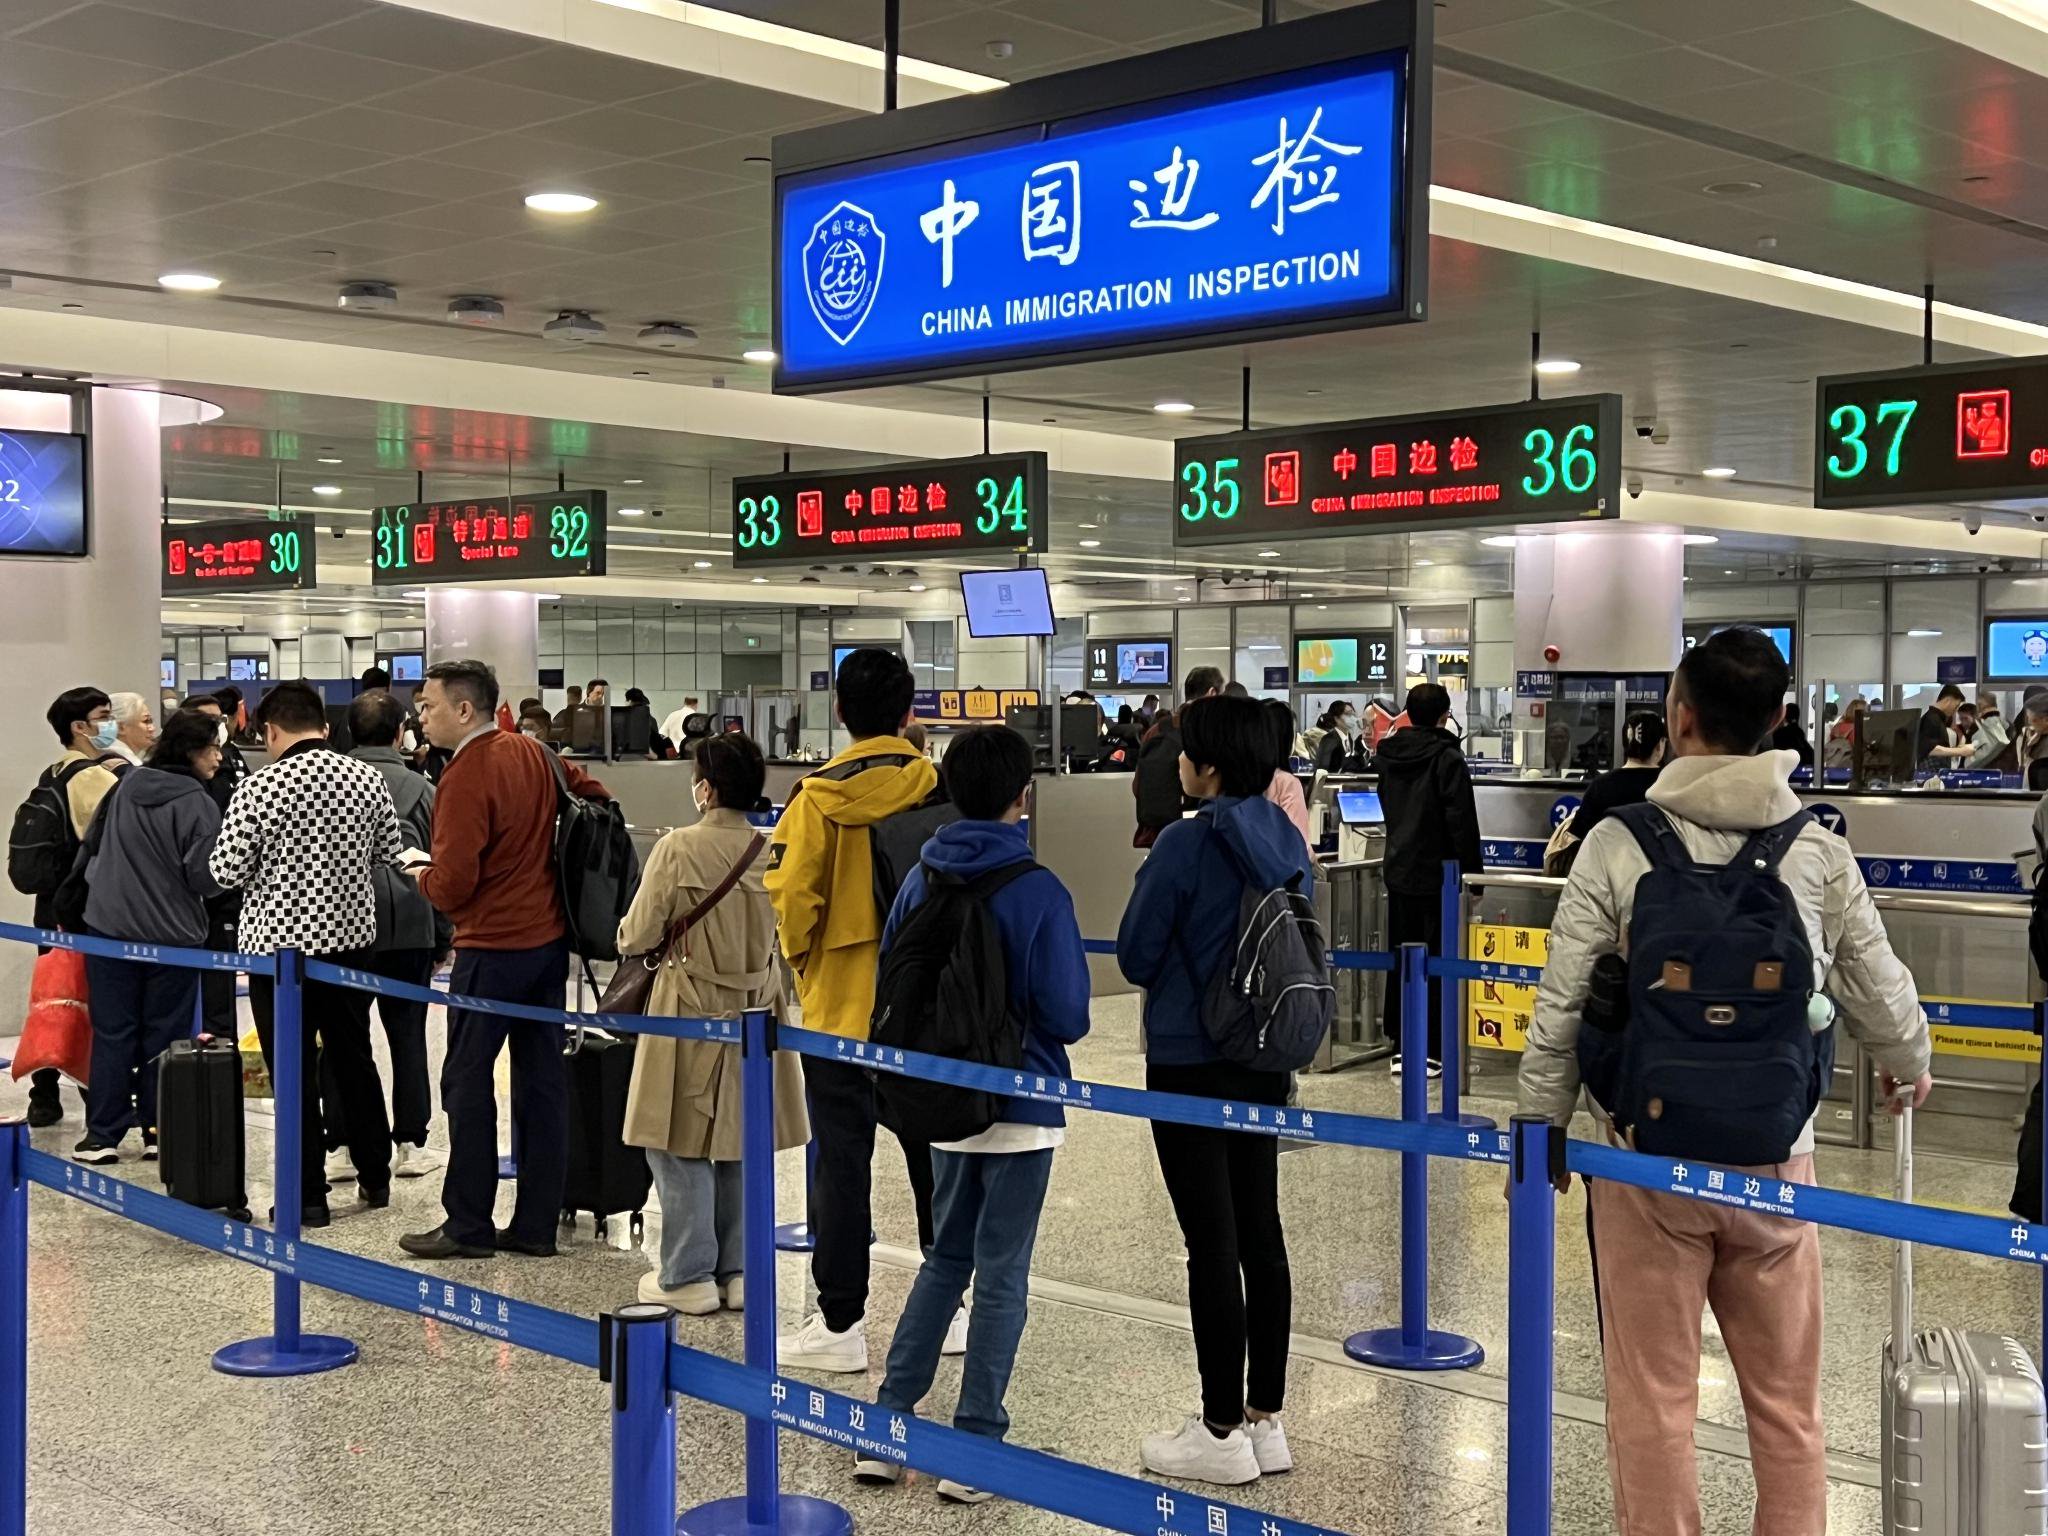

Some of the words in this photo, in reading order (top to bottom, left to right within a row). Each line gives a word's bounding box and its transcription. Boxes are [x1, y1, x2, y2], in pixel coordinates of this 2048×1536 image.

[920, 106, 1363, 288] 中国边检
[921, 309, 993, 336] CHINA
[1005, 278, 1172, 326] IMMIGRATION
[1188, 249, 1361, 300] INSPECTION
[1333, 436, 1480, 481] 中国边检
[1522, 424, 1597, 496] 36
[1827, 400, 1918, 479] 37
[844, 482, 947, 517] 中国边检
[976, 475, 1028, 534] 34
[1181, 458, 1240, 522] 35
[1311, 497, 1346, 513] CHINA
[1429, 484, 1500, 505] INSPECTION
[551, 511, 588, 558] 32
[738, 495, 781, 547] 33
[269, 531, 300, 574] 30
[376, 525, 408, 569] 31
[461, 545, 494, 560] Special
[1093, 648, 1107, 665] 11
[1369, 643, 1387, 661] 12
[1935, 1035, 1963, 1045] Please
[1994, 1041, 2025, 1051] behind
[1222, 1103, 1314, 1128] 中国边检
[1671, 1183, 1694, 1195] CHINA
[1697, 1189, 1746, 1206] IMMIGRATION
[1750, 1199, 1795, 1215] INSPECTION
[1672, 1163, 1796, 1204] 中国边检
[2009, 1247, 2036, 1260] CHINA
[2011, 1224, 2029, 1246] 中
[418, 1279, 509, 1323] 中国边检
[771, 1380, 907, 1444] 中国边检
[771, 1409, 797, 1426] CHINA
[798, 1418, 853, 1444] IMMIGRATION
[855, 1436, 907, 1462] INSPECTION
